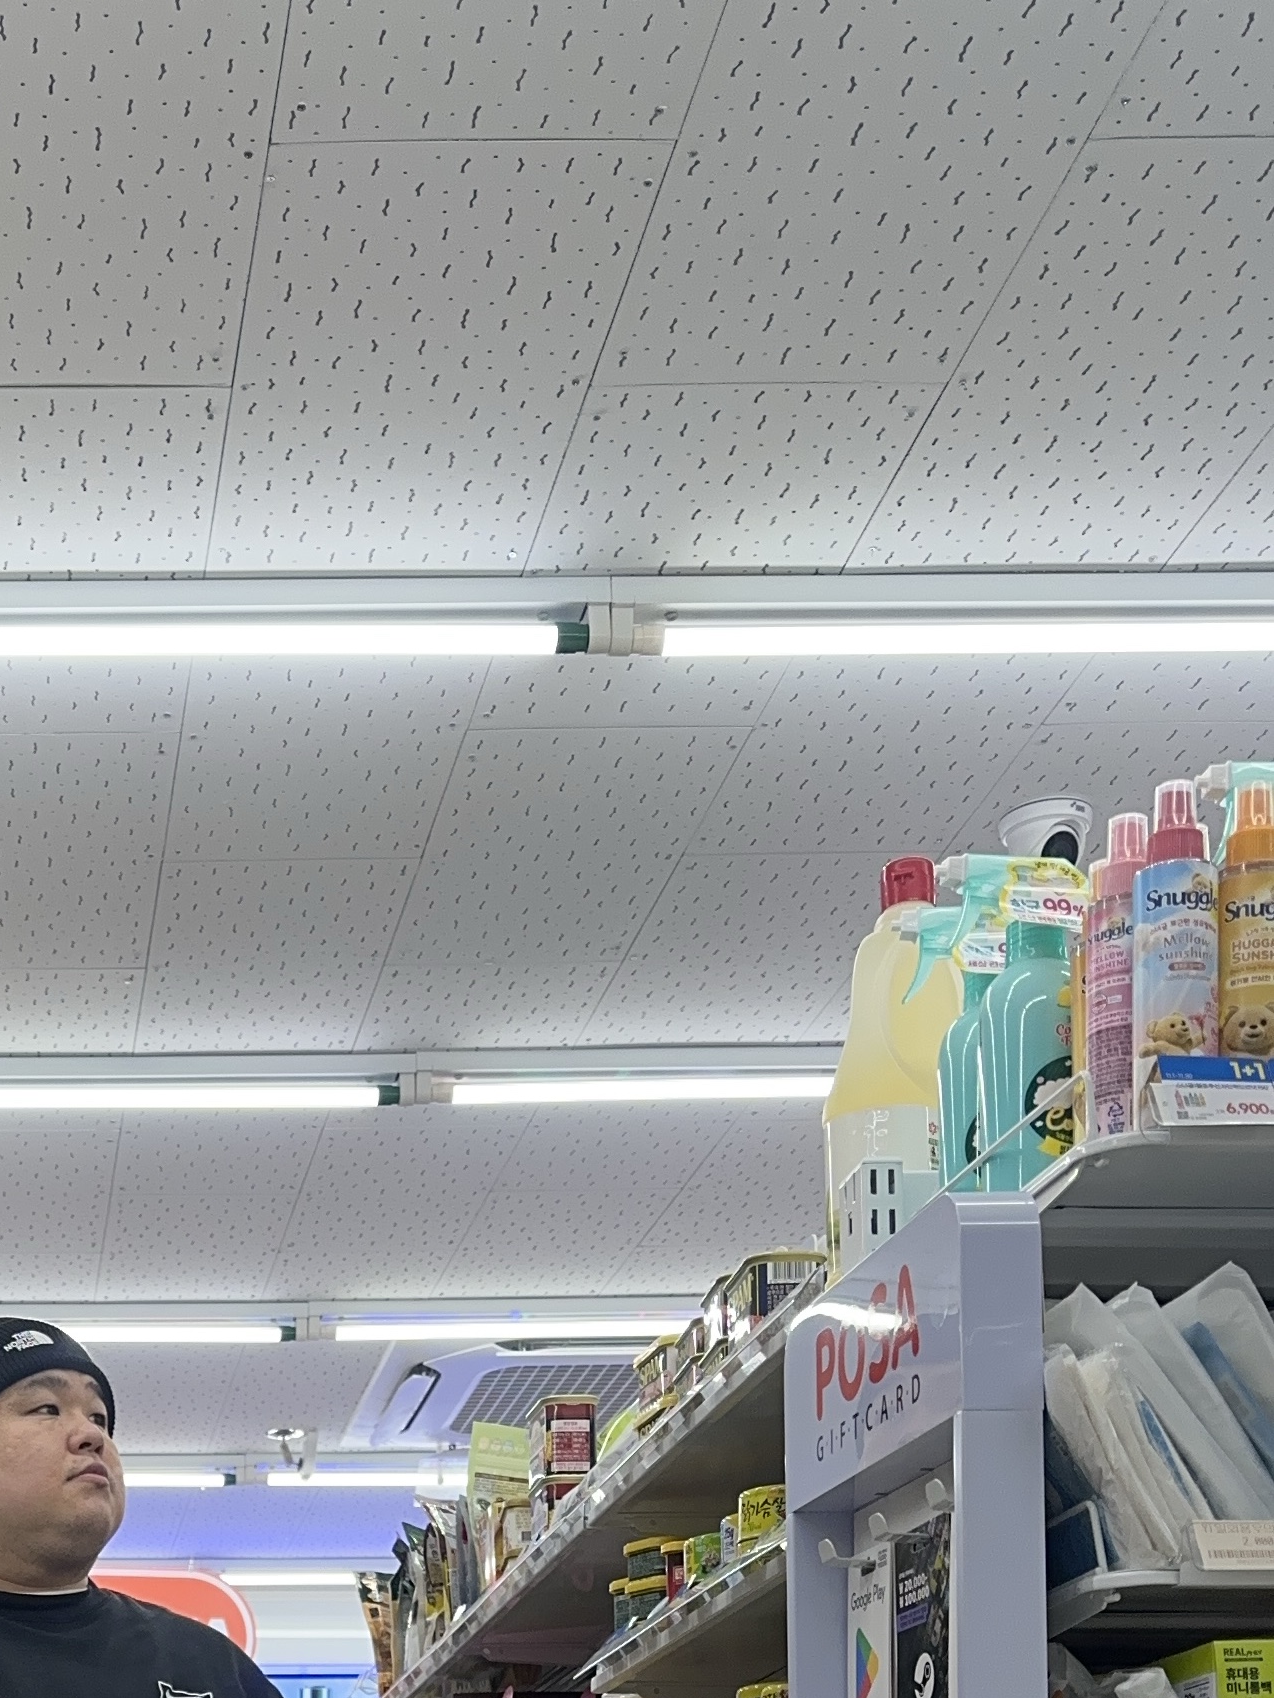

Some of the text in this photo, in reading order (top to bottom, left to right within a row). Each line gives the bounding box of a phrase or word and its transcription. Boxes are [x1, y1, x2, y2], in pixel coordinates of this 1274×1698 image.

[1043, 897, 1084, 916] 99%
[1229, 1061, 1267, 1080] 1+1
[1226, 1102, 1270, 1115] 6,900
[850, 1583, 886, 1612] Google Play
[1225, 1666, 1261, 1681] 휴대용
